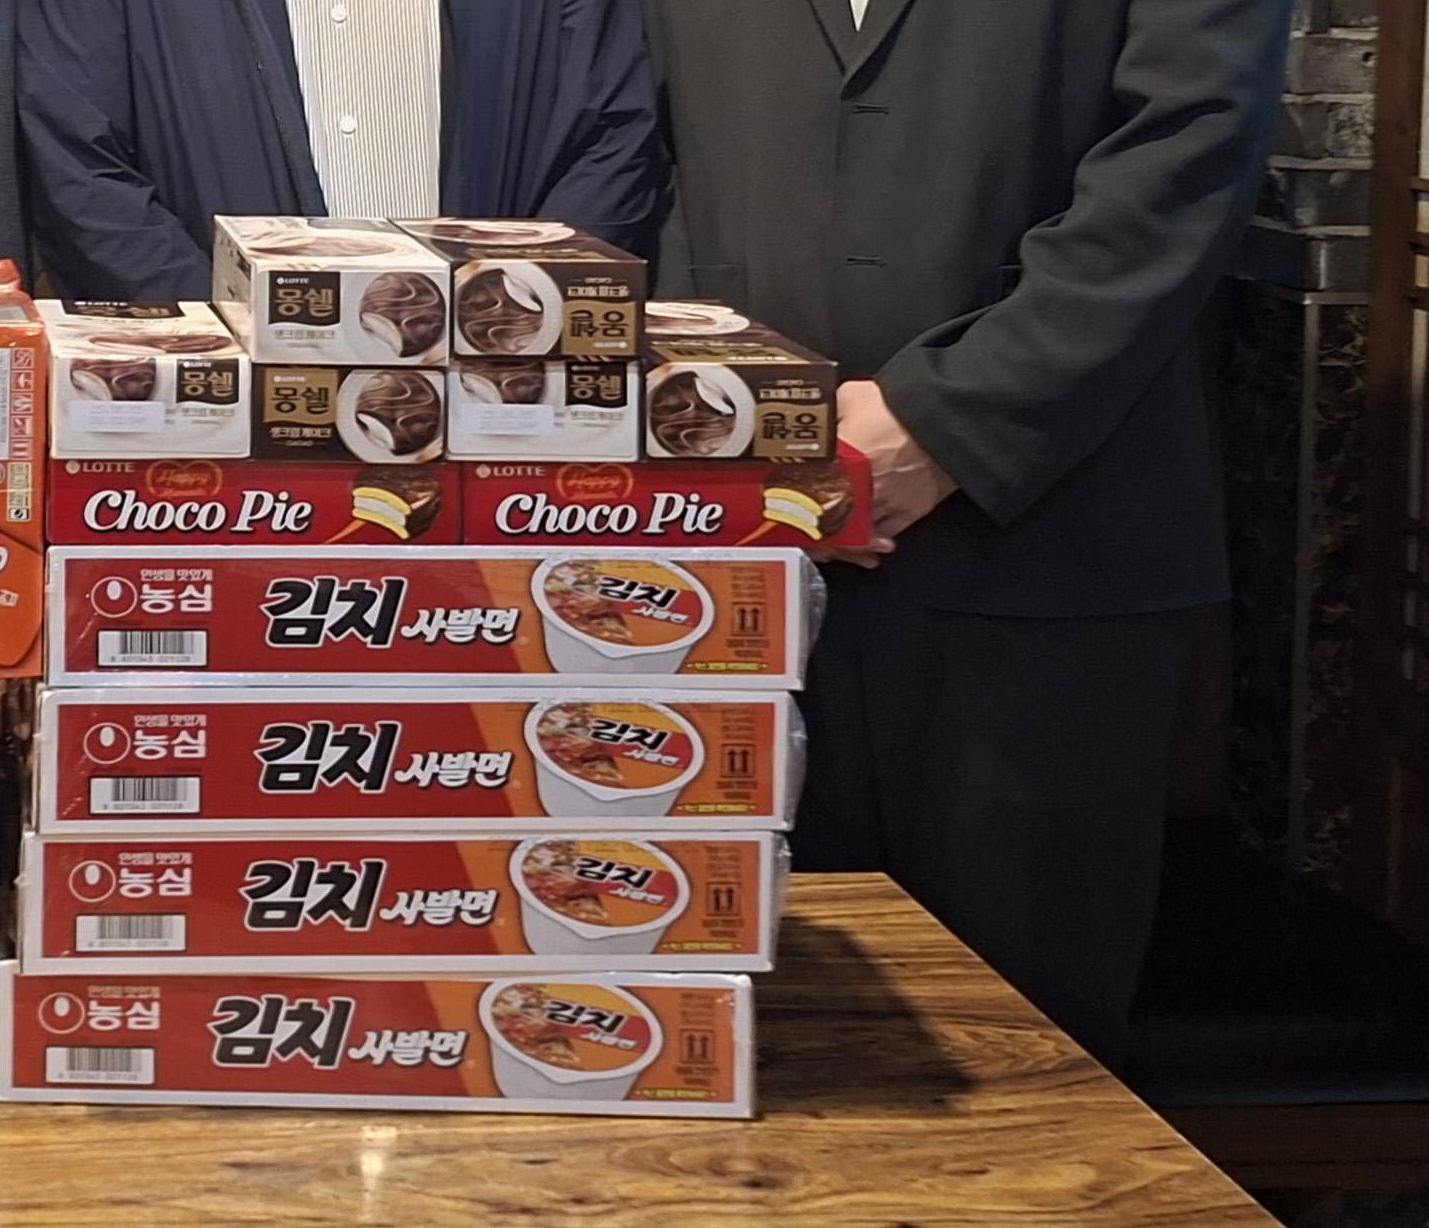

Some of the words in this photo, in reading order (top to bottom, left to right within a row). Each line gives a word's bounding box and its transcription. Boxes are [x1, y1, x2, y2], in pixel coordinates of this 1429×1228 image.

[274, 288, 333, 318] 몽쉘
[569, 310, 630, 338] 몽쉘
[181, 371, 235, 398] 몽쉘
[571, 374, 623, 400] 몽쉘
[271, 386, 330, 415] 몽쉘
[761, 412, 822, 440] 몽쉘
[82, 462, 136, 473] LOTTE
[493, 465, 546, 477] LOTTE
[84, 489, 227, 532] Choco
[230, 489, 313, 533] Pie
[495, 492, 637, 534] Choco
[642, 493, 723, 535] Pie
[140, 584, 213, 614] 농심
[595, 576, 681, 610] 김치
[260, 576, 408, 648] 김치
[401, 606, 520, 644] 사발면
[133, 730, 207, 761] 농심
[588, 718, 673, 752] 김치
[253, 720, 402, 794] 김치
[395, 751, 514, 788] 사발면
[118, 867, 192, 899] 농심
[574, 856, 656, 889] 김치
[238, 858, 388, 932] 김치
[380, 889, 500, 926] 사발면
[87, 1001, 161, 1031] 농심
[544, 1000, 629, 1034] 김치
[207, 994, 355, 1071] 김치
[349, 1030, 469, 1067] 사발면
